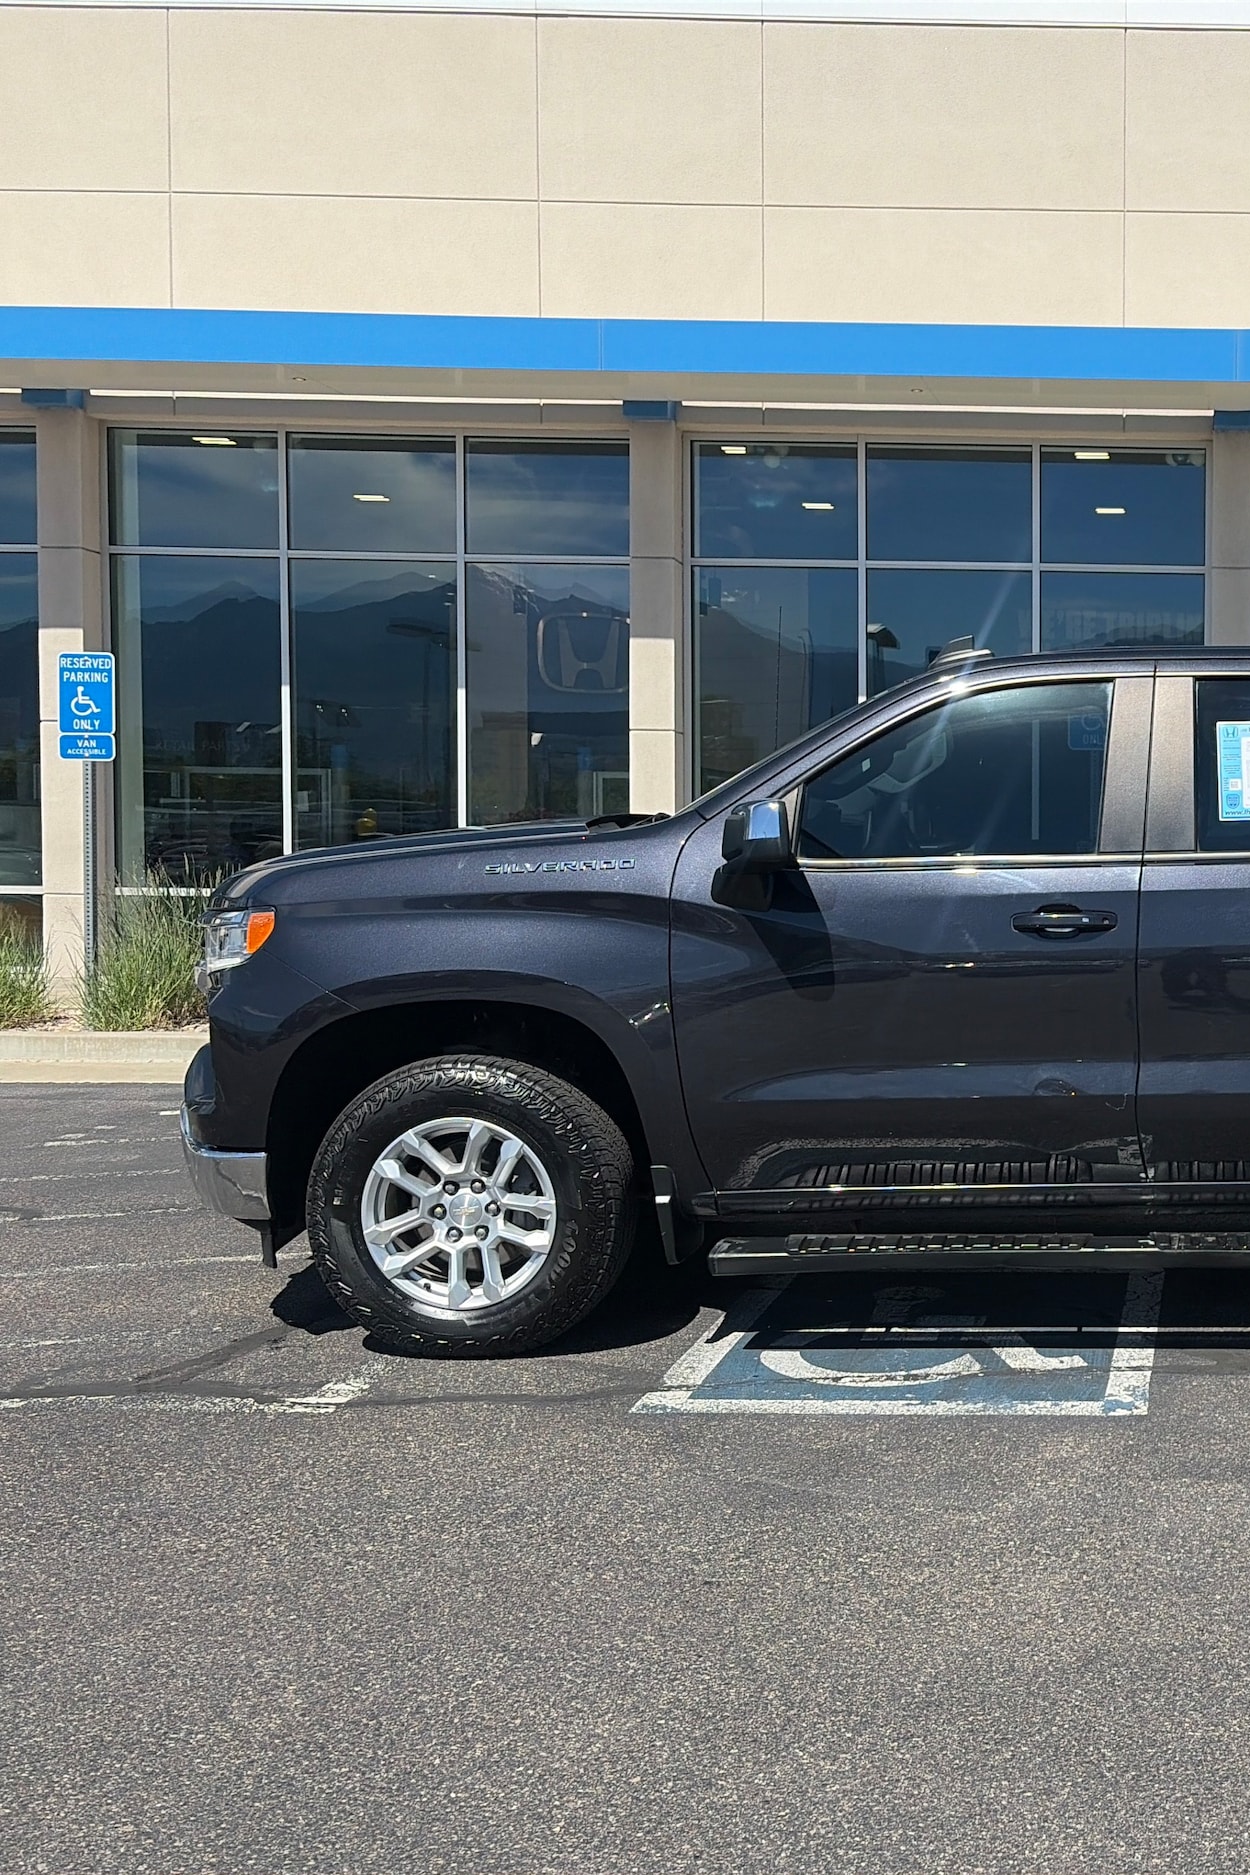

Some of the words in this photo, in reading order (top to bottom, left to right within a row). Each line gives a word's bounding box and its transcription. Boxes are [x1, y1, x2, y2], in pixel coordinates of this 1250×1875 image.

[60, 657, 112, 669] RESERVED
[63, 671, 109, 683] PARKING
[73, 719, 101, 730] ONLY
[77, 739, 97, 748] VAN
[1082, 734, 1105, 745] ONL
[484, 858, 636, 875] SILVERADO
